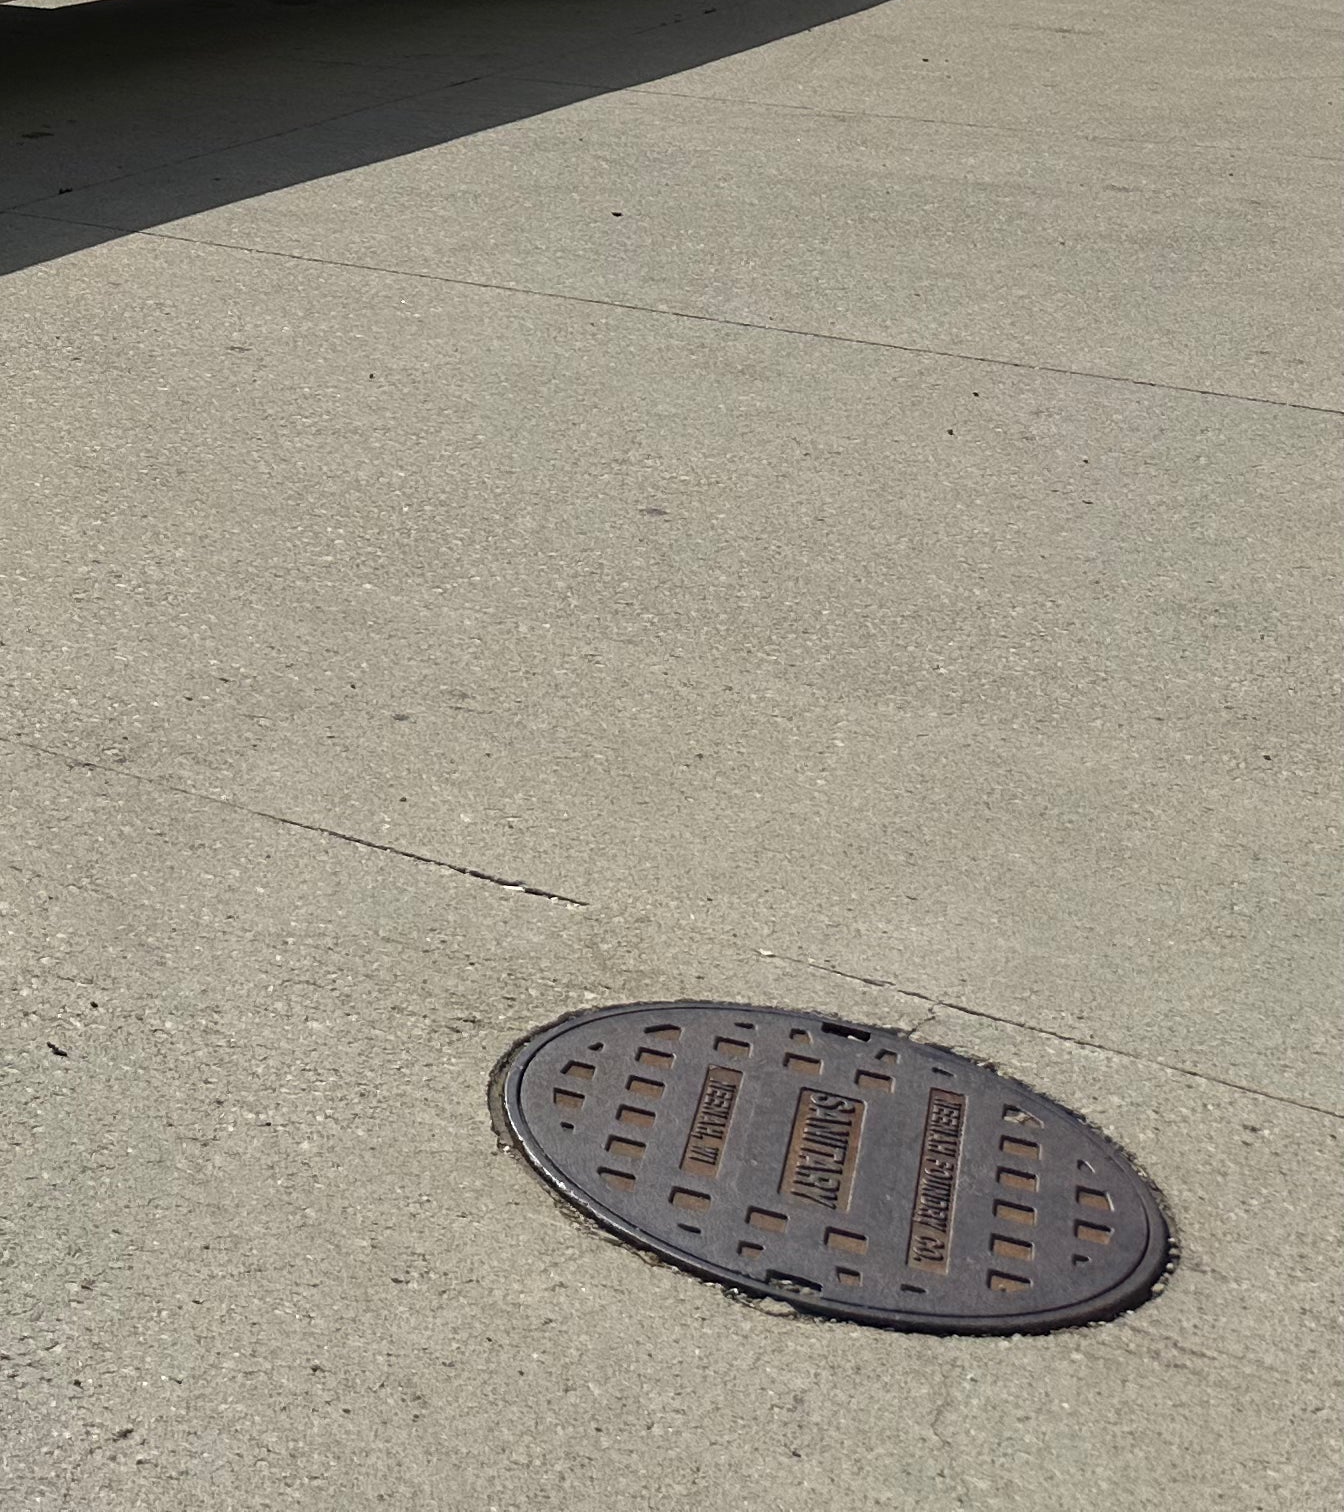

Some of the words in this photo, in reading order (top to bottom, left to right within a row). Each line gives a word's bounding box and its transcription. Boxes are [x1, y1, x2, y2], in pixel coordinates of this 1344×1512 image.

[791, 1093, 856, 1210] SANITARY
[925, 1097, 961, 1159] NEENAH
[913, 1155, 956, 1235] FOUNDRY
[910, 1234, 946, 1265] CO.
